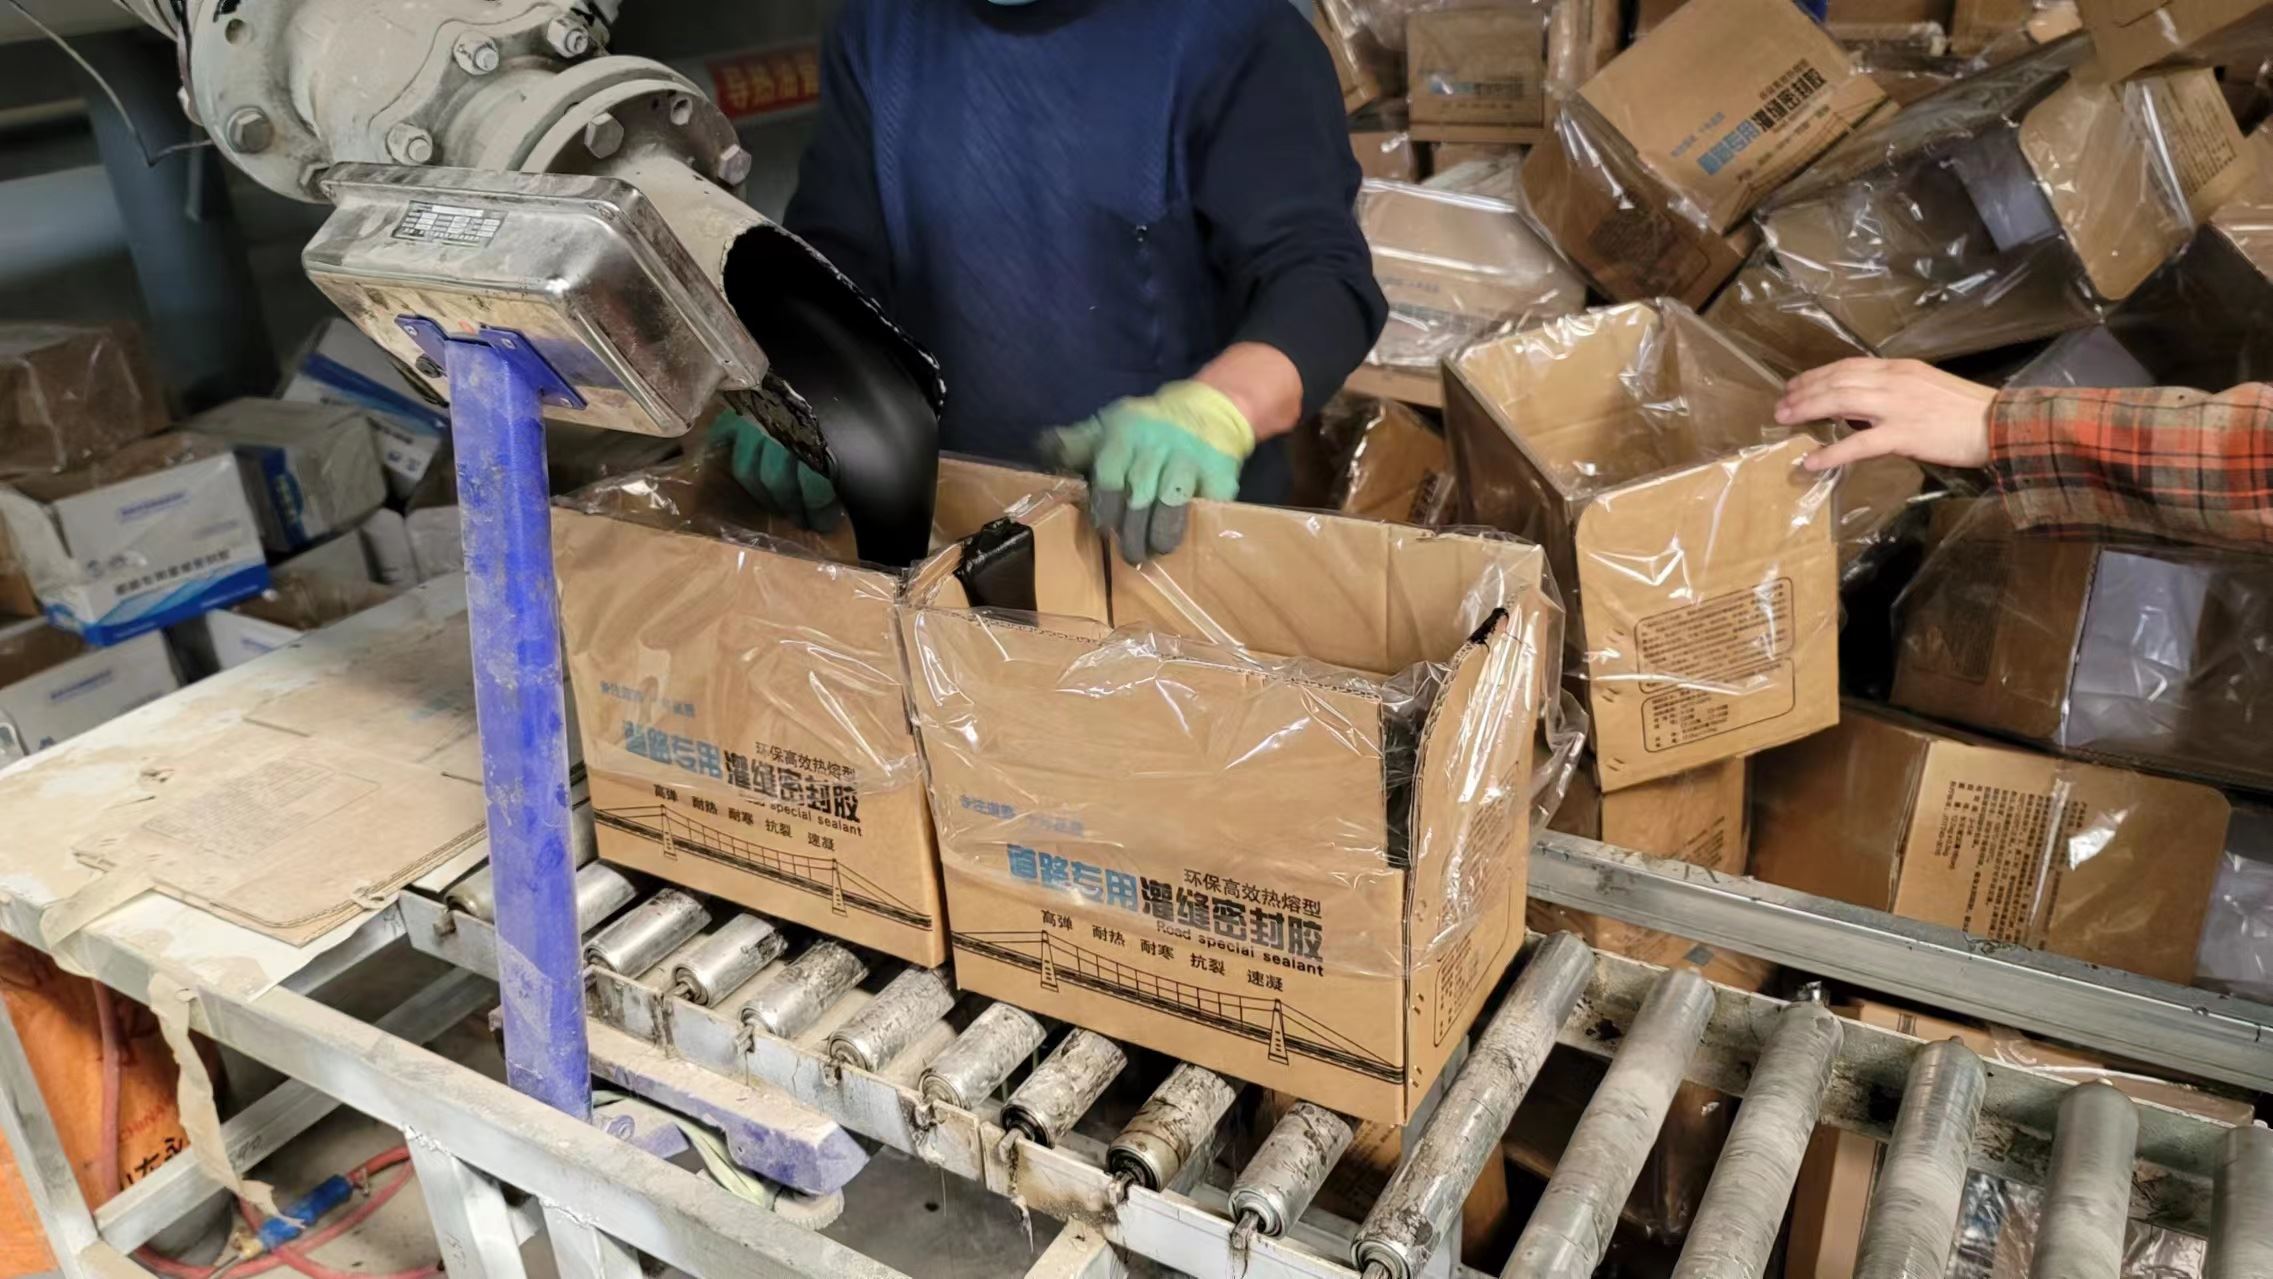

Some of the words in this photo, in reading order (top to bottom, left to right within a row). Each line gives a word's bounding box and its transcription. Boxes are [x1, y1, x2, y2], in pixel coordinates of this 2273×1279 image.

[692, 796, 718, 815] 耐热
[728, 807, 754, 825] 耐寒
[765, 819, 792, 838] 抗裂
[808, 832, 835, 850] 速凝
[770, 802, 812, 821] special
[818, 816, 863, 836] sealant
[1184, 869, 1322, 918] 环保高效热熔型
[1041, 909, 1073, 930] 高弹
[1092, 924, 1125, 948] 耐热
[1140, 938, 1175, 960] 耐寒
[1190, 952, 1226, 976] 抗裂
[1247, 969, 1284, 992] 速凝
[1157, 920, 1192, 940] Road
[1198, 934, 1254, 957] special
[1263, 952, 1324, 977] sealant
